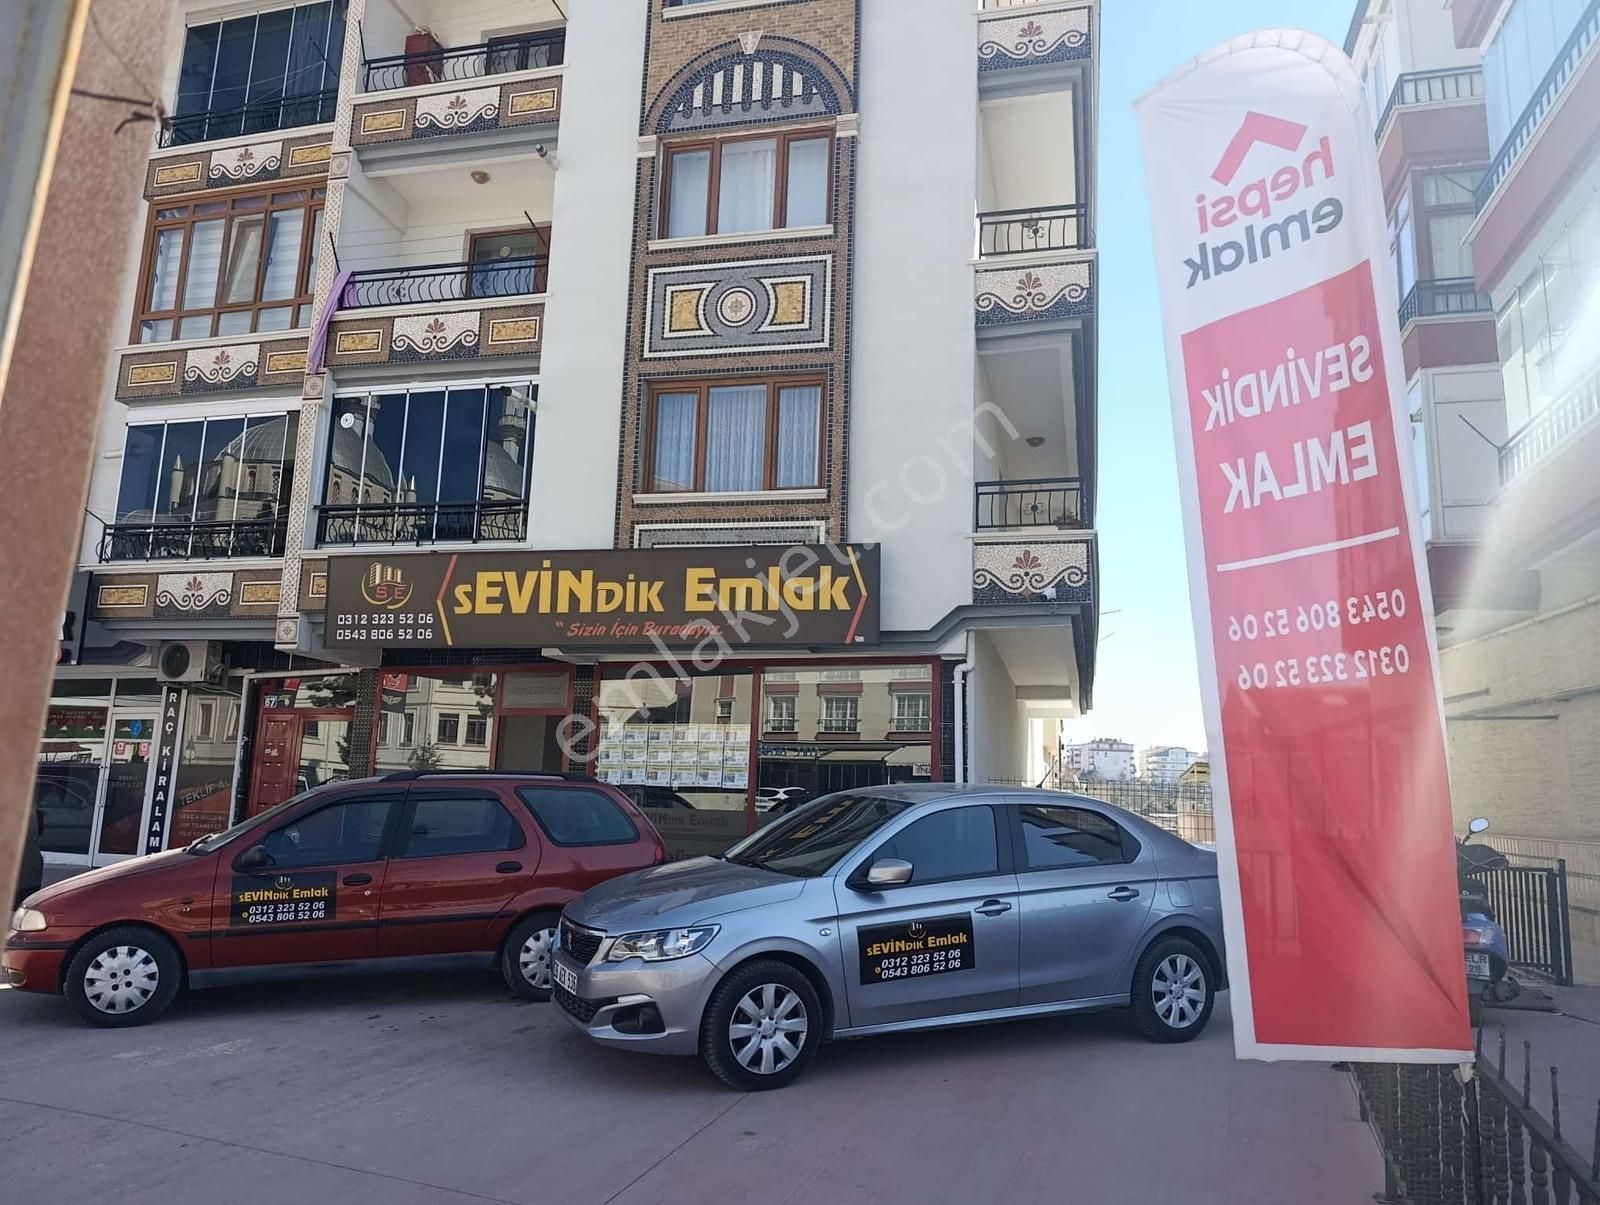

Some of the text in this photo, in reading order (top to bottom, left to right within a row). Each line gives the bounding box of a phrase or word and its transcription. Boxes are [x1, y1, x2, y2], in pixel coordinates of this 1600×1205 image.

[685, 565, 851, 612] Emlak
[337, 613, 434, 625] 0312 323 52 06
[336, 628, 433, 640] 0543 806 52 06
[567, 623, 607, 637] Sizin
[610, 617, 638, 639] İçin
[264, 697, 276, 708] 67
[148, 745, 172, 856] KİRALAM
[293, 887, 329, 899] Emlak
[249, 901, 325, 914] 0312 323 52 06
[248, 910, 325, 923] 0543 806 52 06
[927, 932, 968, 948] Emlak
[881, 949, 961, 969] 0312 323 52 06
[881, 959, 961, 979] 0543 806 52 06
